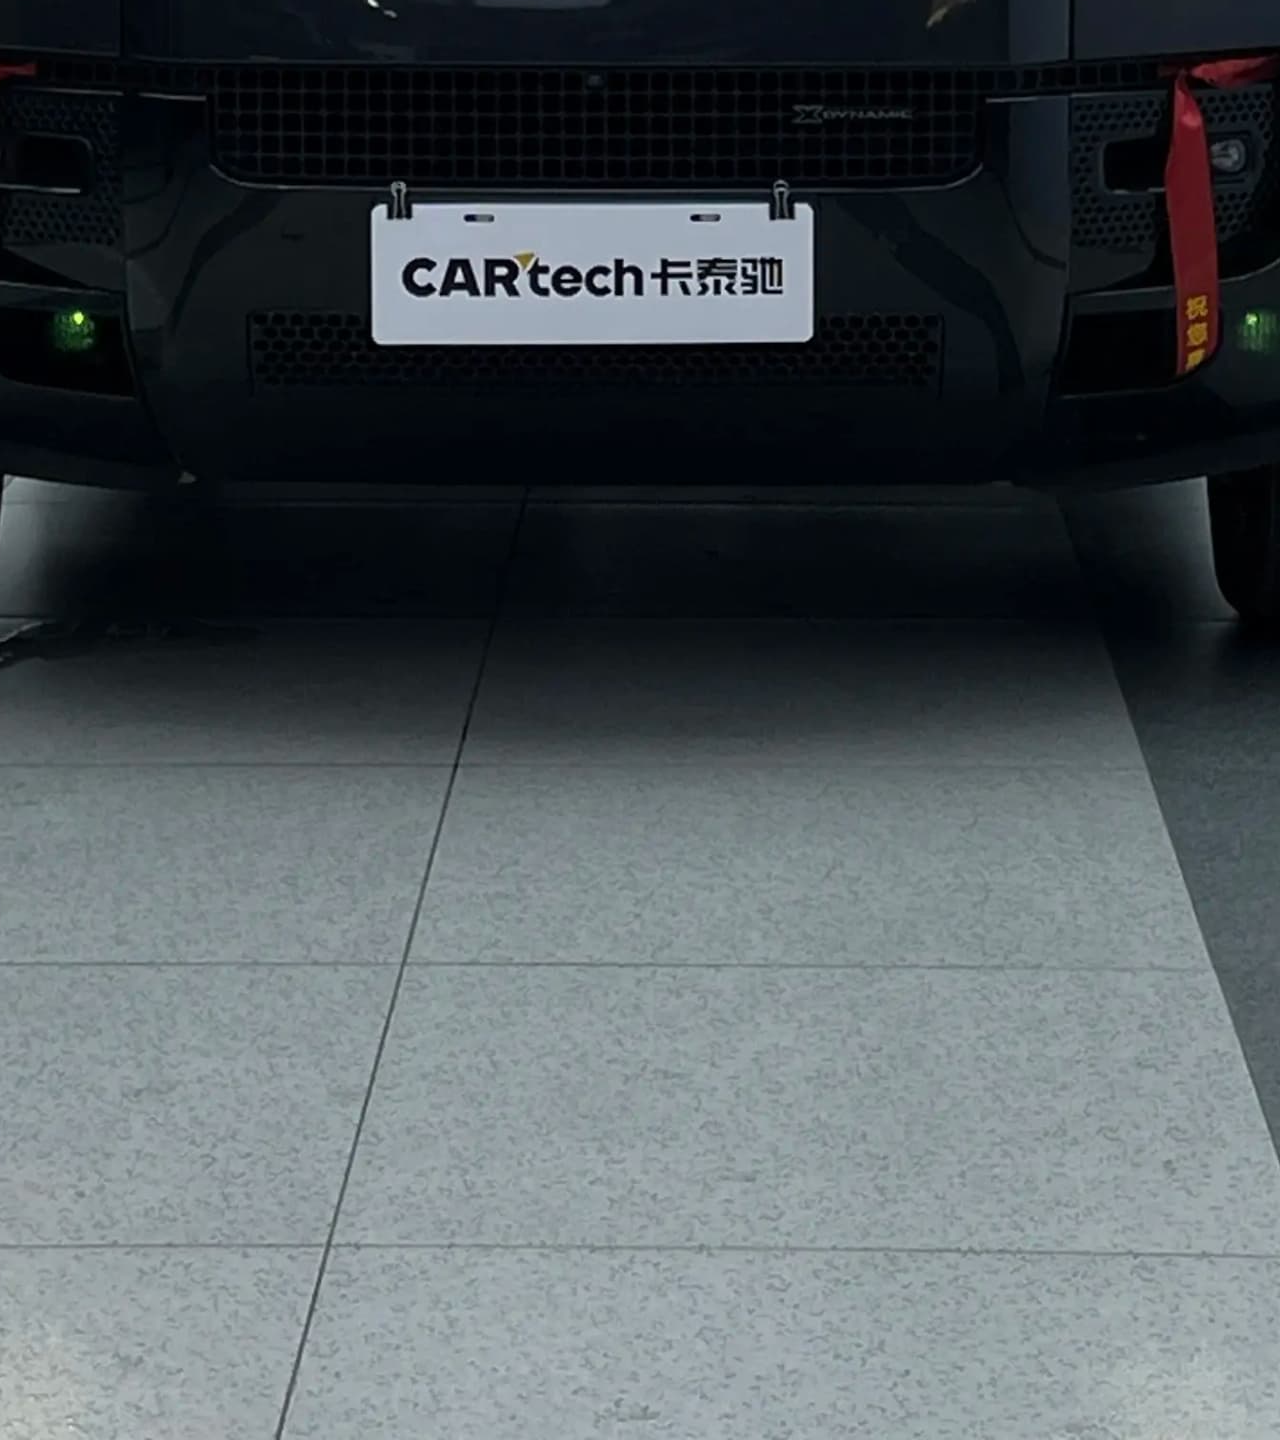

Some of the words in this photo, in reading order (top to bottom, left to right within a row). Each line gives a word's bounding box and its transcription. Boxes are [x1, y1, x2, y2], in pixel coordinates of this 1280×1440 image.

[401, 256, 645, 297] CARtech
[650, 258, 784, 297] 卡泰驰
